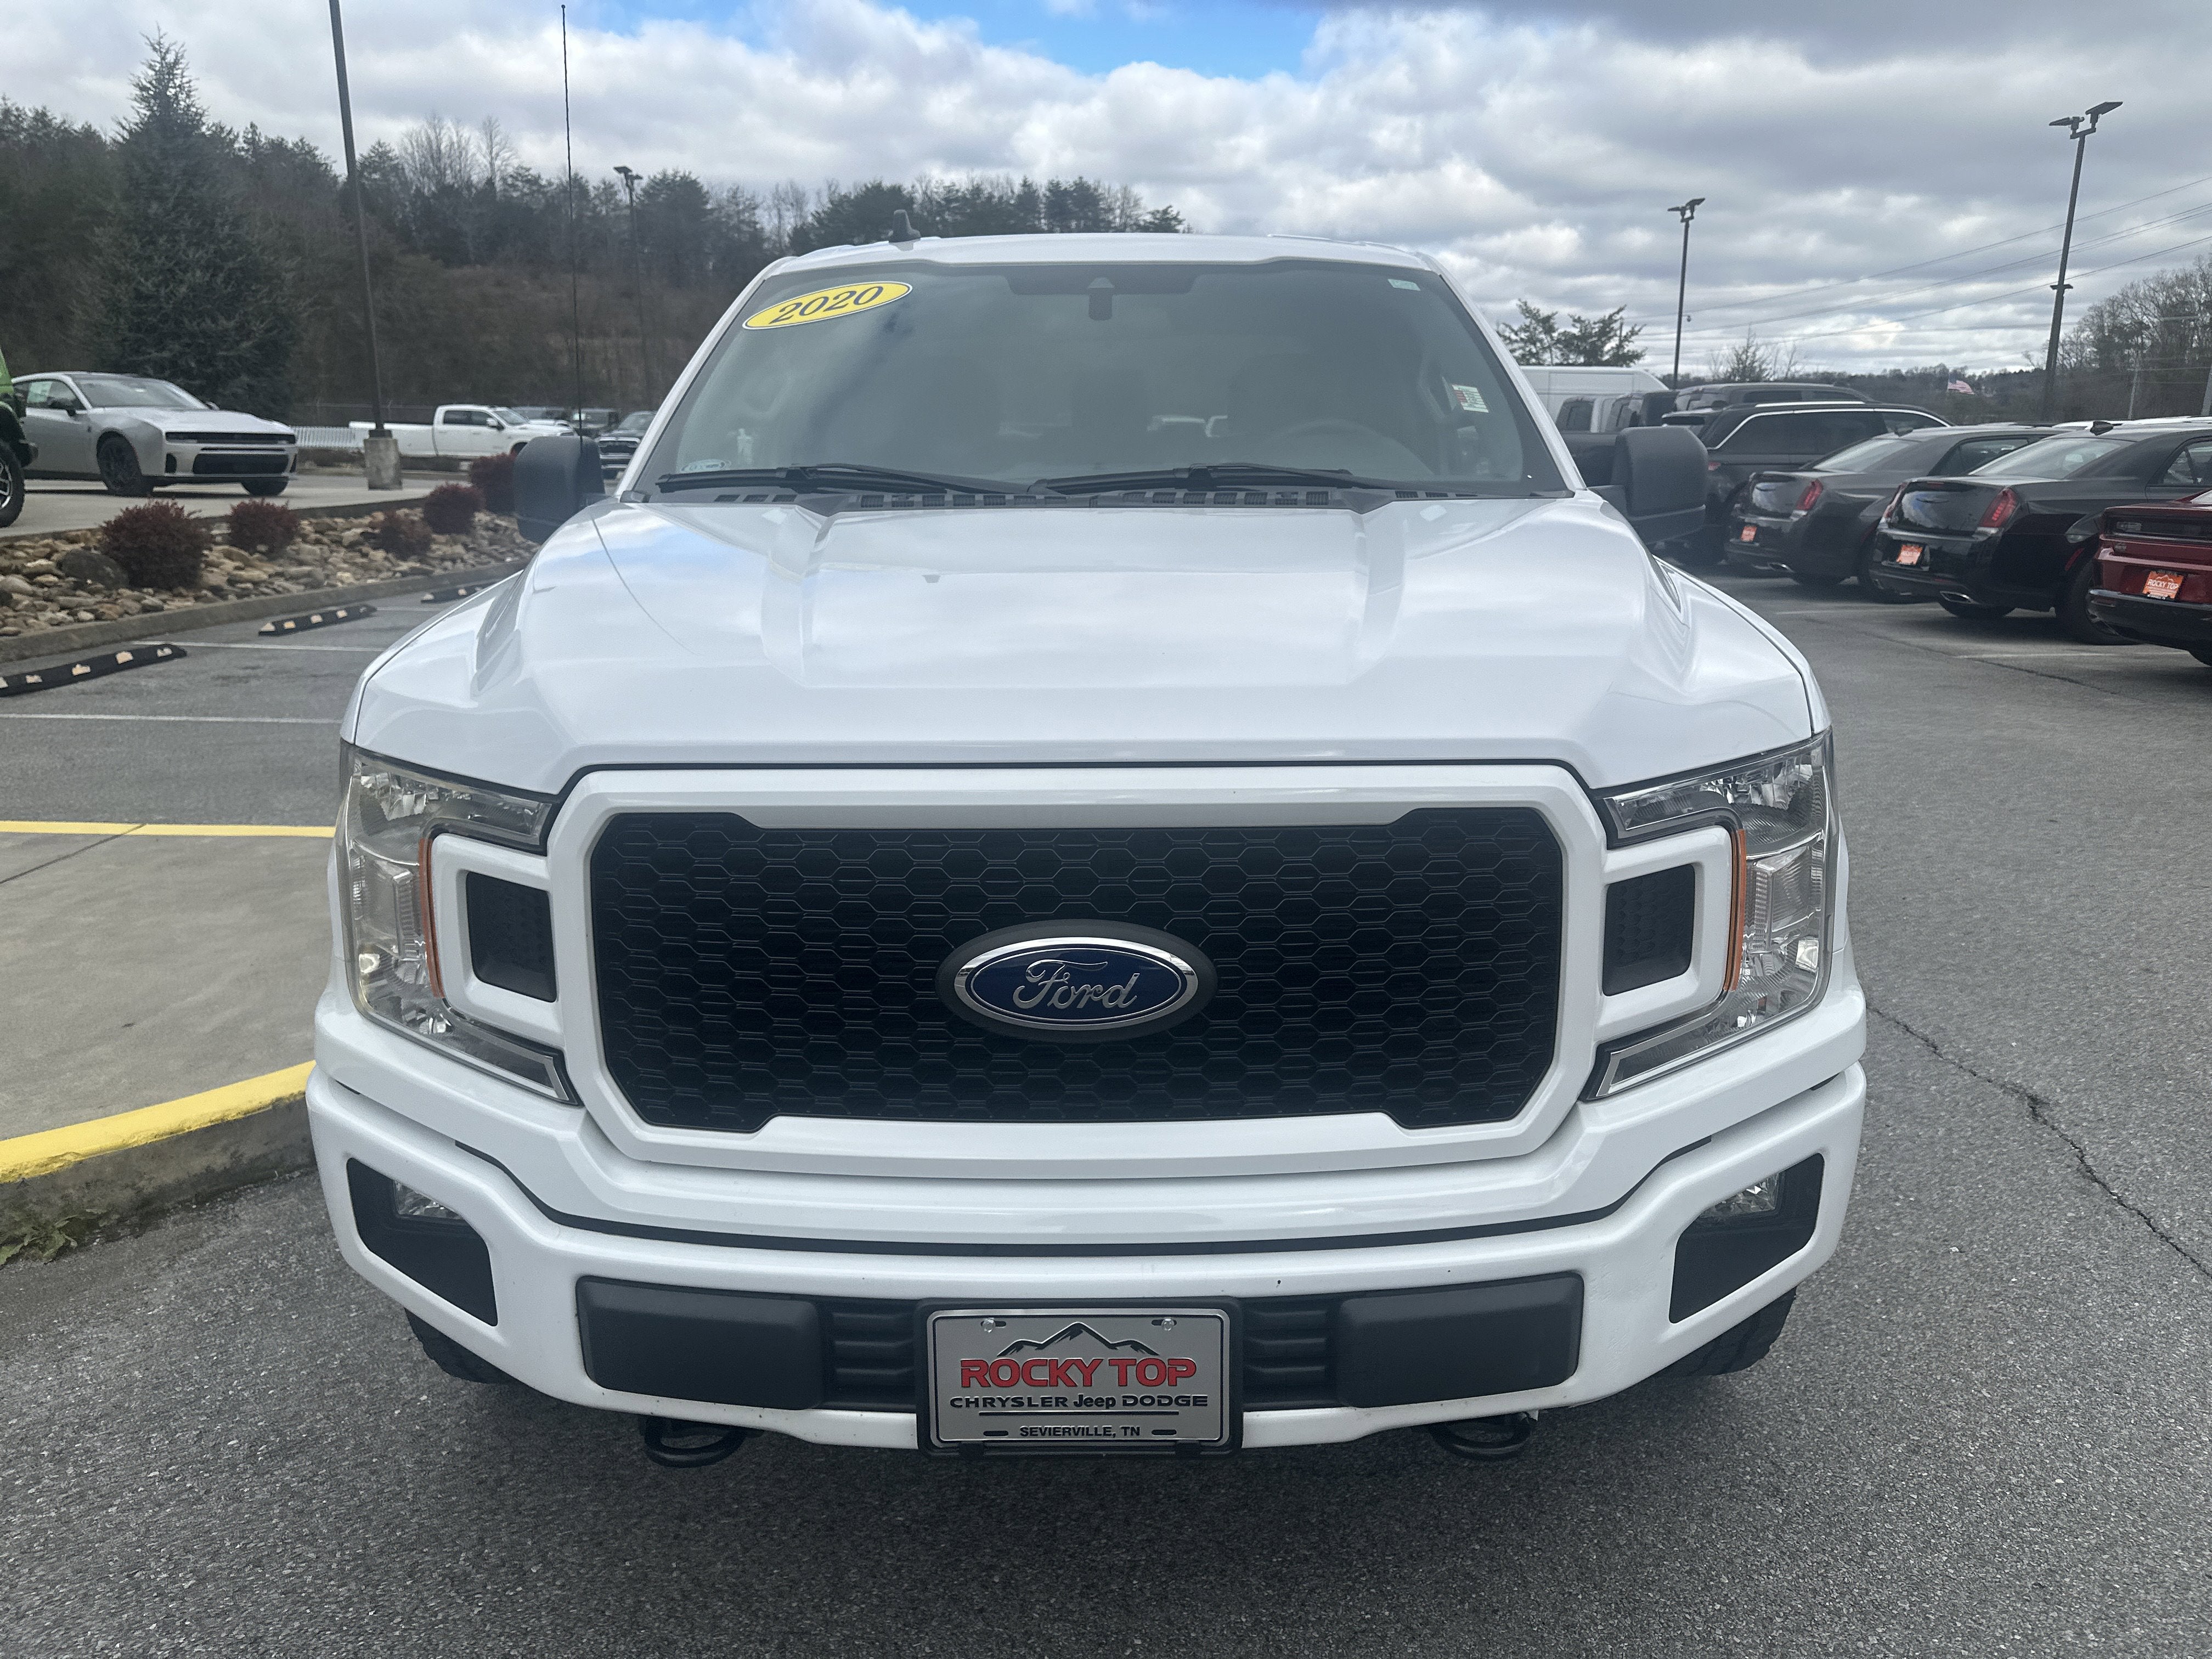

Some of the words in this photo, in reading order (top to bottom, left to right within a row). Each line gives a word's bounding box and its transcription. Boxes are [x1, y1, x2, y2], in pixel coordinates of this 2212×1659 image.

[769, 286, 884, 324] 2020
[2147, 579, 2167, 588] ROCKY
[1013, 959, 1141, 1009] Ford
[961, 1358, 1103, 1387] ROCKY
[1109, 1358, 1197, 1387] TOP
[950, 1396, 1068, 1408] CHRYSLER
[1074, 1393, 1116, 1409] Jeep
[1122, 1395, 1208, 1407] DODGE
[1020, 1425, 1116, 1438] SEVIERVILLE,
[1122, 1425, 1141, 1436] TN
